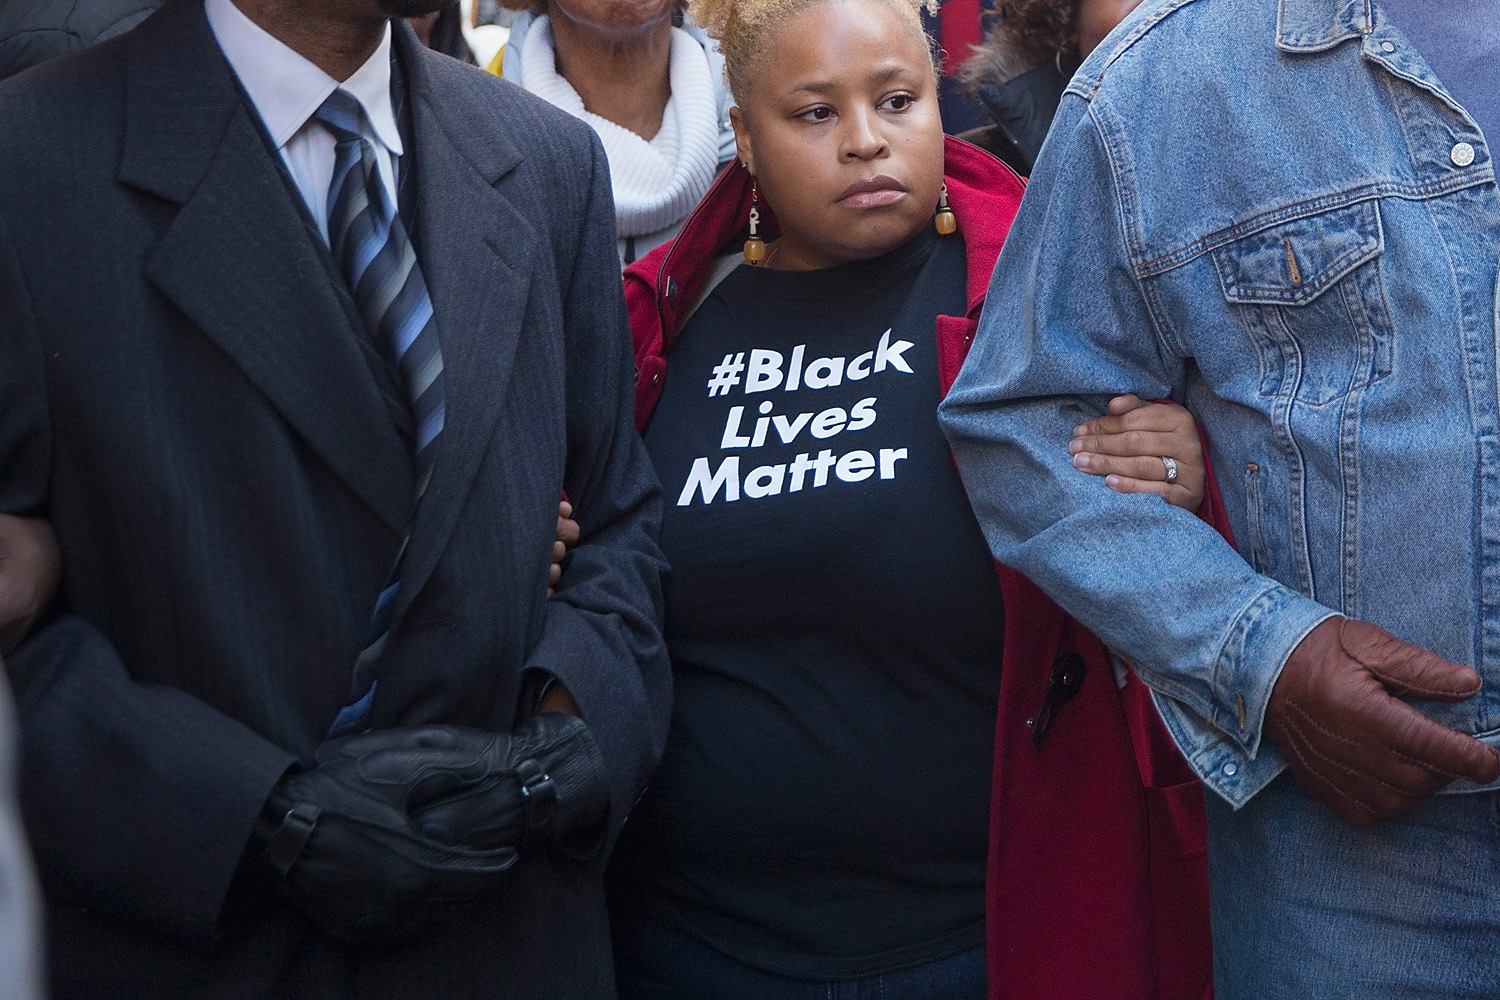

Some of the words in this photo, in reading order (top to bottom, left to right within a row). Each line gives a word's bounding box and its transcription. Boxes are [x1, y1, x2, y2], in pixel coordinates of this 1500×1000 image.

[706, 328, 915, 397] #Black
[720, 397, 877, 449] Lives
[676, 448, 908, 506] Matter
